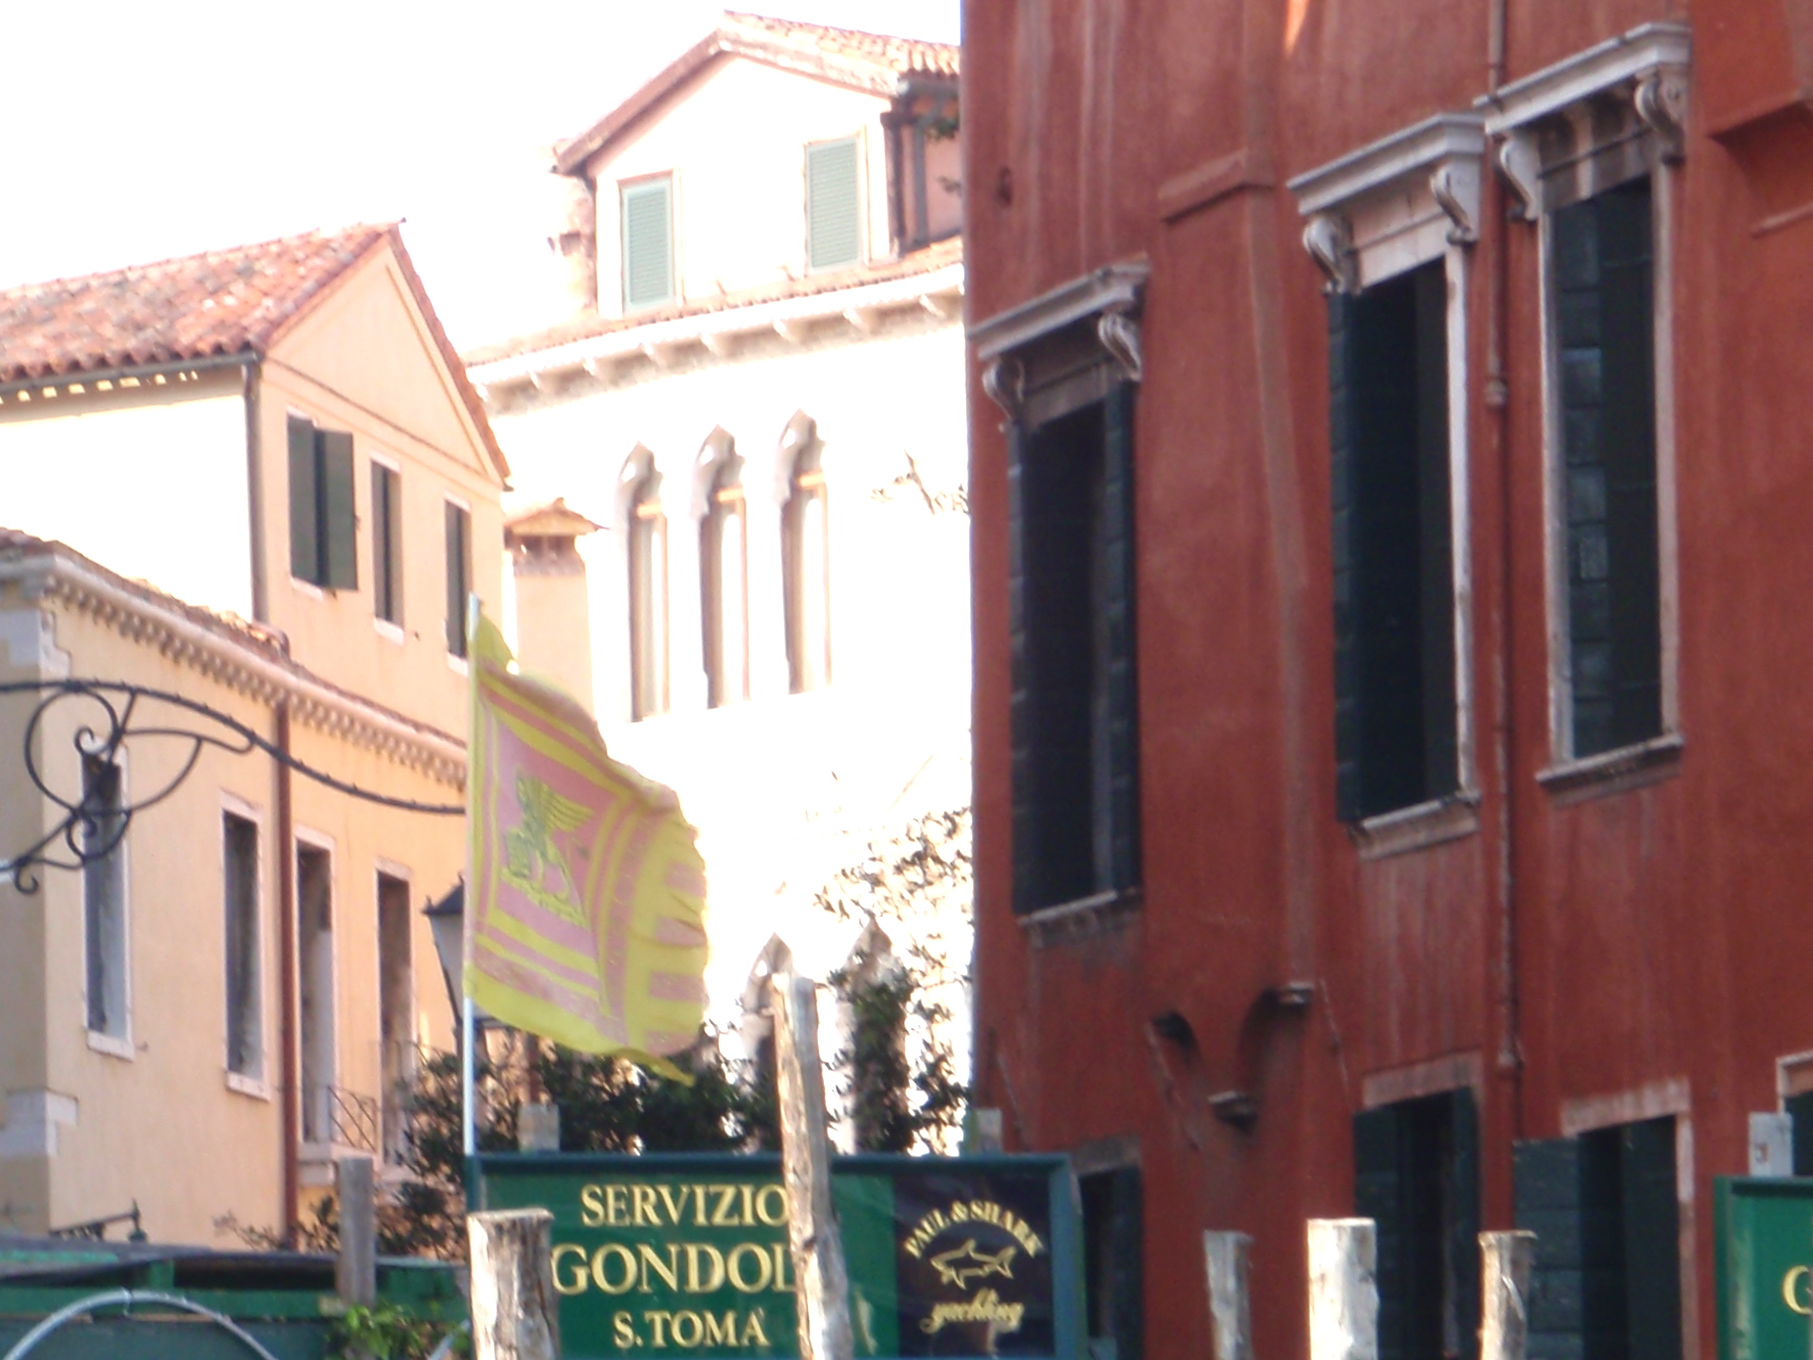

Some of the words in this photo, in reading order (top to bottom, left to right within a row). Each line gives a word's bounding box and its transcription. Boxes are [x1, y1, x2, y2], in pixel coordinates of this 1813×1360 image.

[581, 1183, 790, 1227] SERVIZIO
[903, 1208, 951, 1259] PAUL
[551, 1242, 797, 1295] GONDOL
